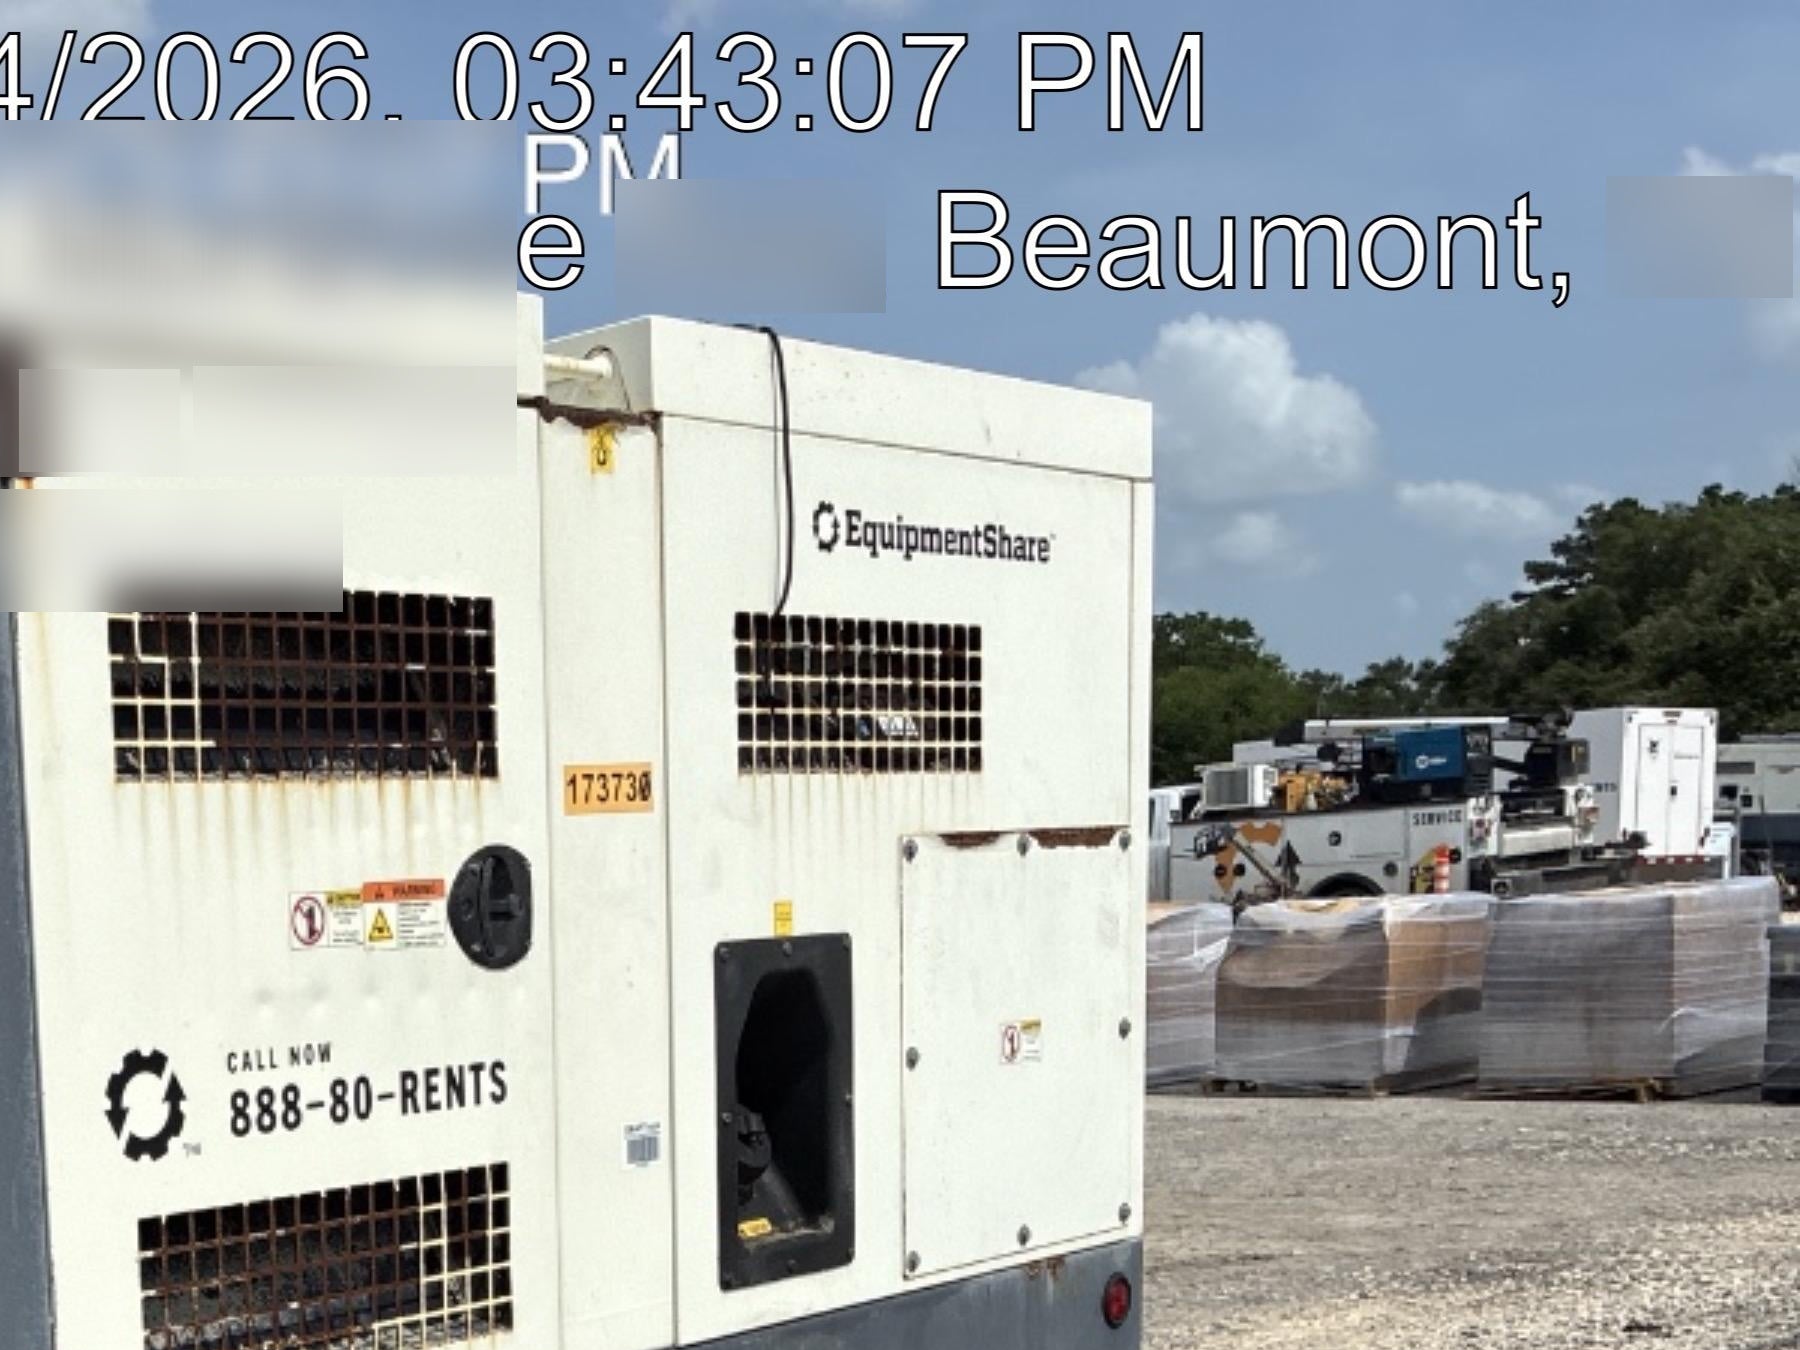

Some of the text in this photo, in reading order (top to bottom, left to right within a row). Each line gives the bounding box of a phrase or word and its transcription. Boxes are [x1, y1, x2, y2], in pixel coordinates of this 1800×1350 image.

[845, 509, 1051, 564] EquipmentShare
[226, 1041, 333, 1075] CALL NOW
[229, 1060, 509, 1138] 888-80-RENTS
